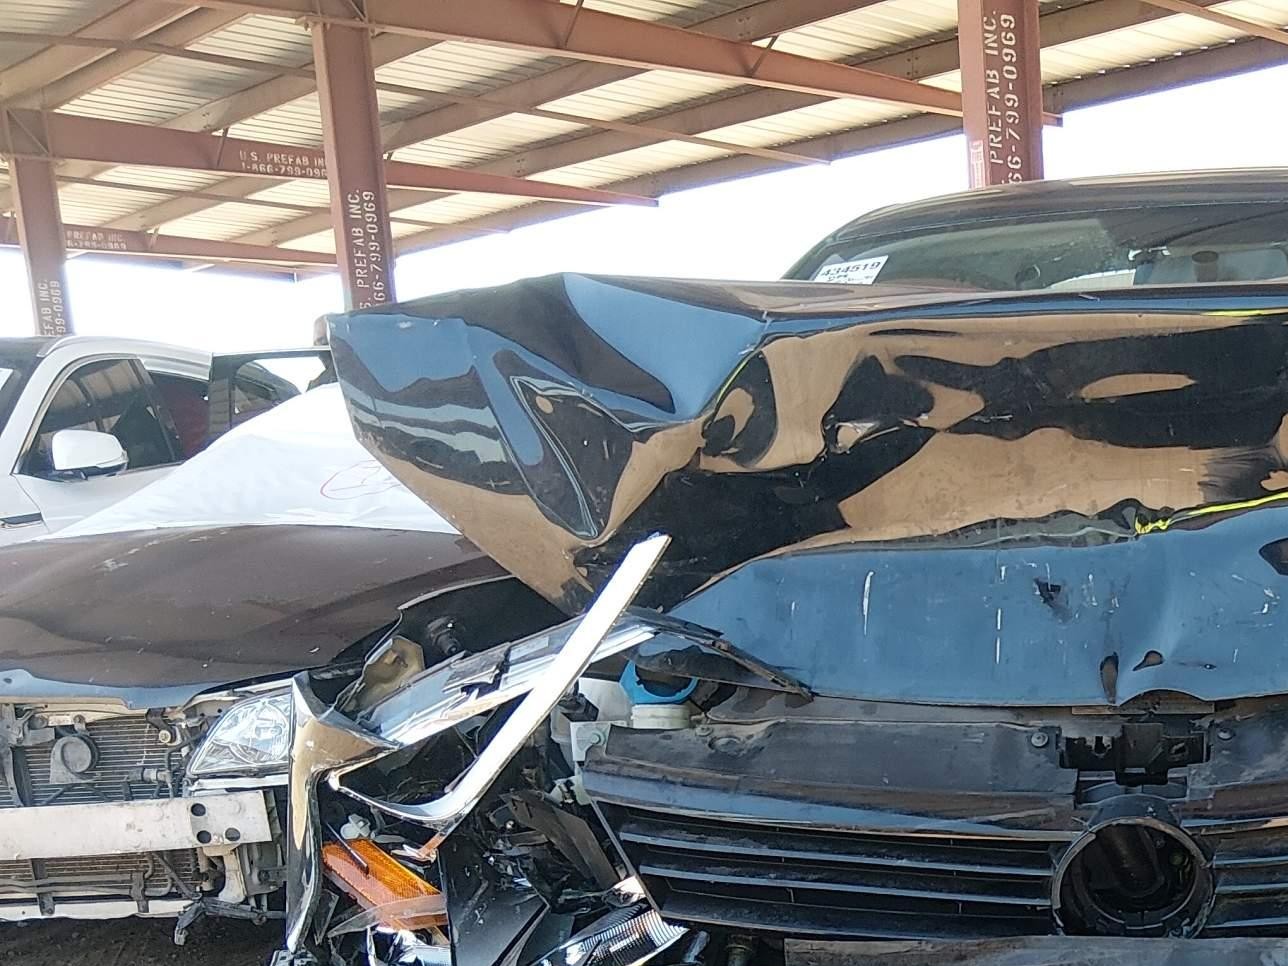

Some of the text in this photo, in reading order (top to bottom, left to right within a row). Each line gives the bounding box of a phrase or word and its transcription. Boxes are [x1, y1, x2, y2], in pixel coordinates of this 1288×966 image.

[983, 10, 1003, 164] PREFAB INC.
[266, 152, 309, 166] PREFAB
[347, 189, 362, 219] INC.
[351, 227, 370, 288] PREFAB
[362, 191, 386, 306] 66-799-0969
